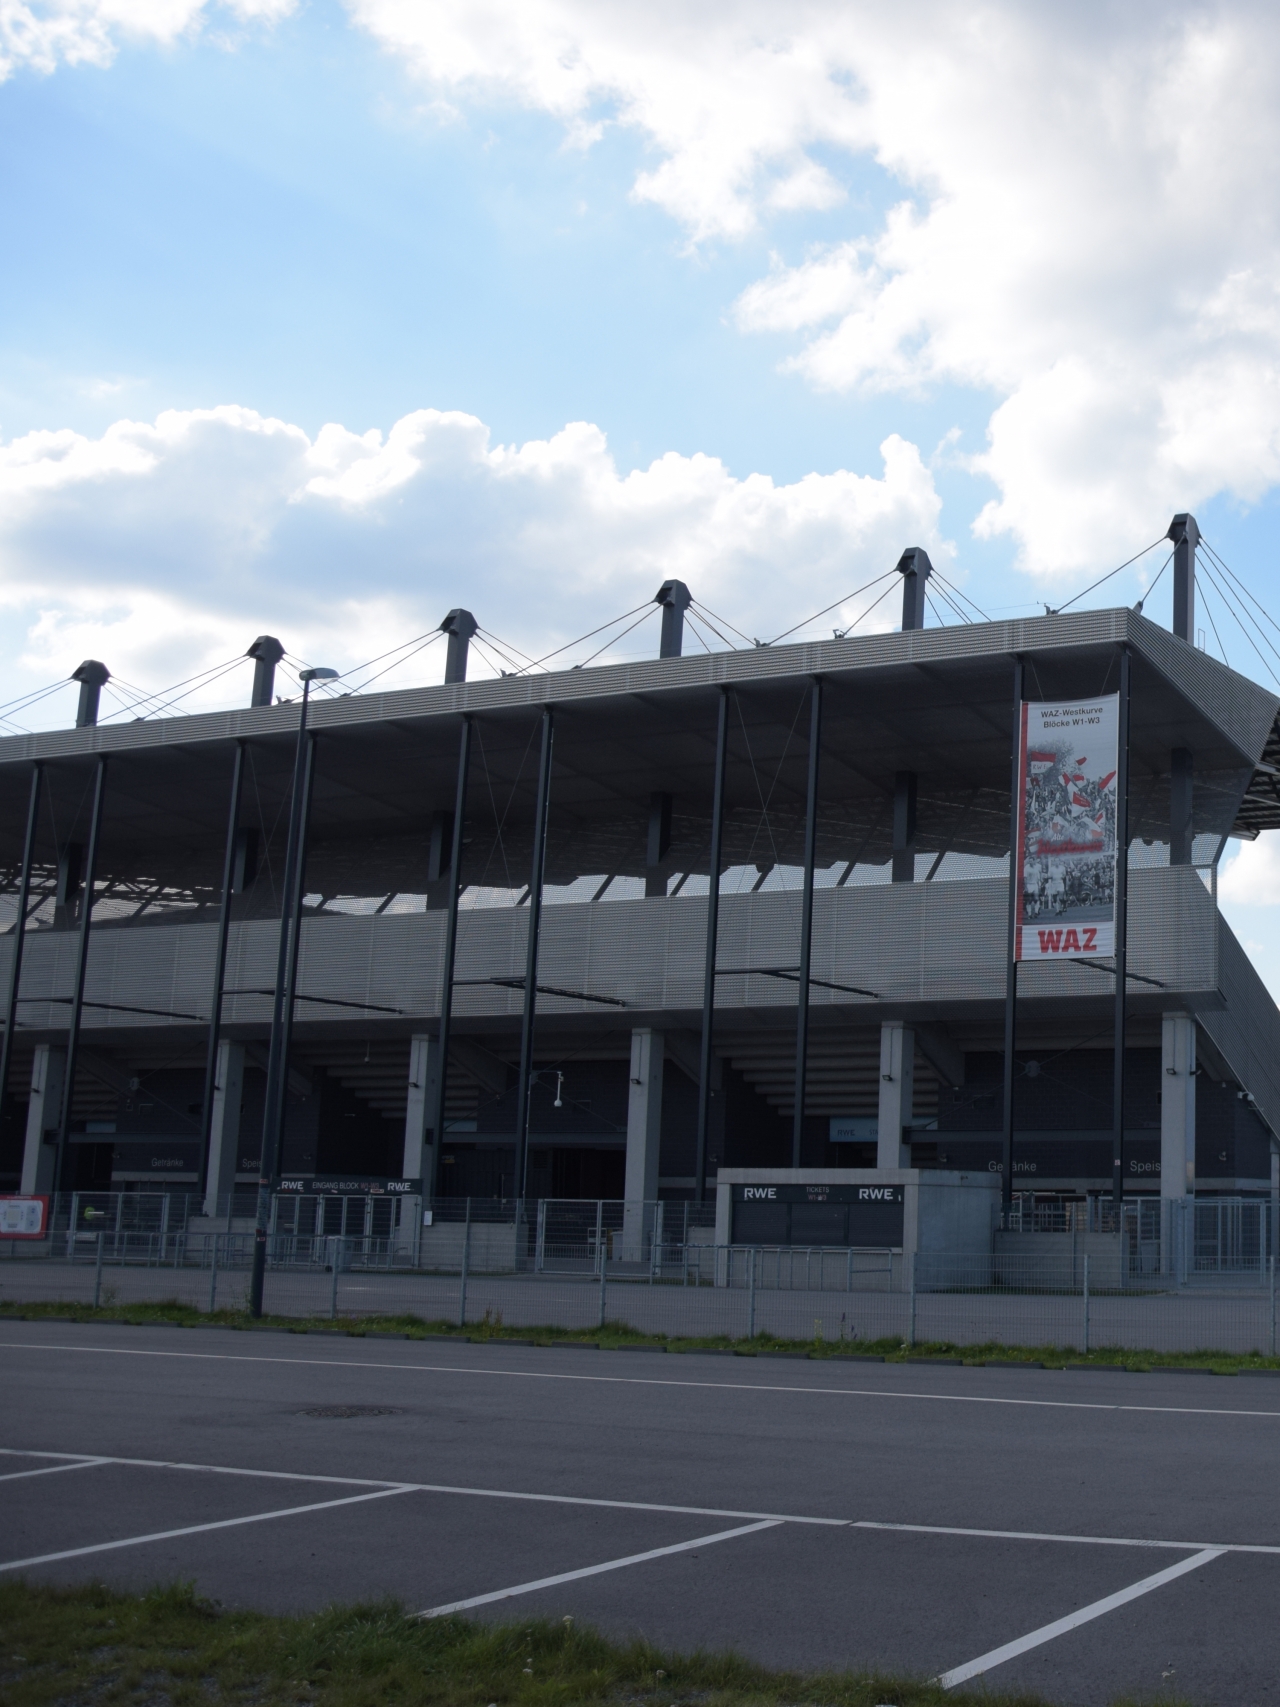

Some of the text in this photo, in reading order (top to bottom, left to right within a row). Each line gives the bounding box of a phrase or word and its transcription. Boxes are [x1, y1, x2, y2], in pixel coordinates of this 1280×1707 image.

[1041, 707, 1103, 718] WAZ-Westkurve
[1043, 717, 1100, 728] Blöcke W1-W3
[1037, 927, 1097, 953] WAZ
[151, 1158, 184, 1167] Getränke
[242, 1158, 262, 1169] Speis
[988, 1160, 1037, 1172] Geänke
[1129, 1160, 1161, 1173] Speis
[281, 1181, 304, 1190] RWE
[312, 1181, 339, 1189] EINGANG
[387, 1182, 411, 1191] RWE
[744, 1187, 894, 1200] RWE RWE
